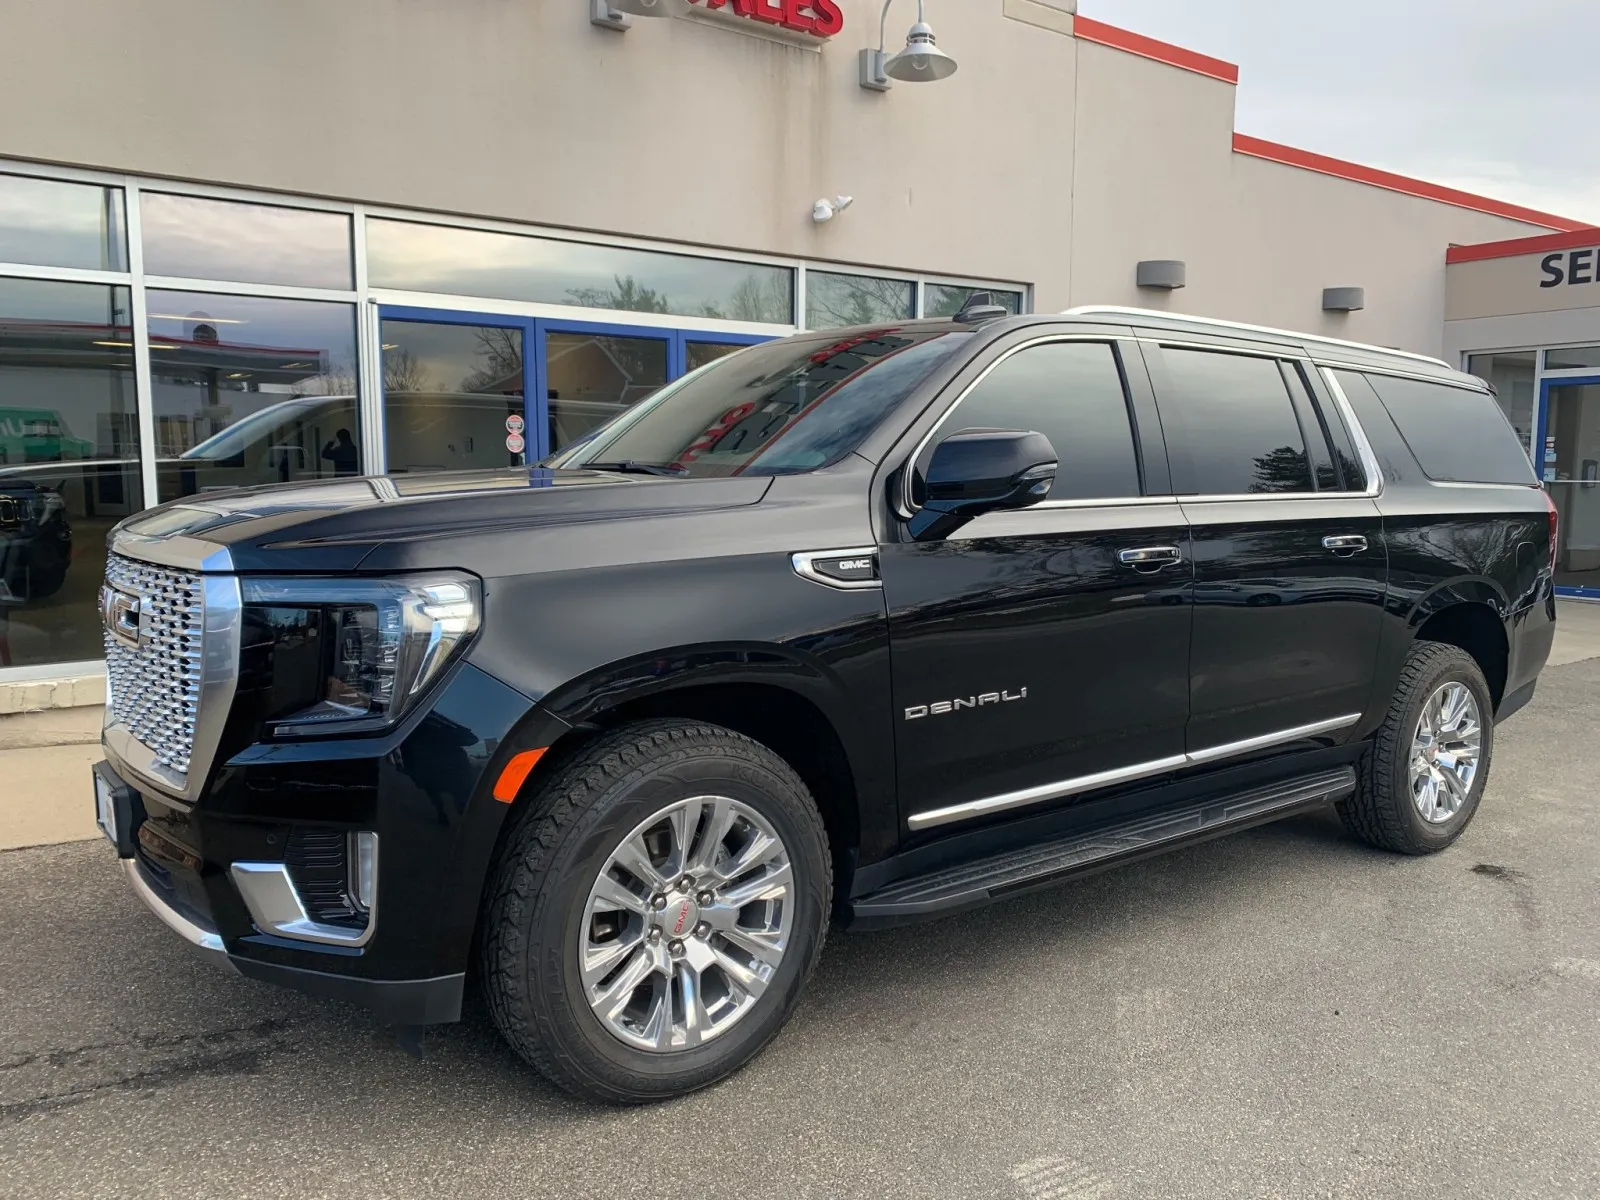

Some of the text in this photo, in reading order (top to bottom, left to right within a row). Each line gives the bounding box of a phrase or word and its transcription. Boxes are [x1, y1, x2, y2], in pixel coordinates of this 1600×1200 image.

[1540, 248, 1600, 288] SE
[839, 559, 870, 570] GMC
[904, 686, 1027, 721] DENALI
[673, 899, 690, 934] GMC
